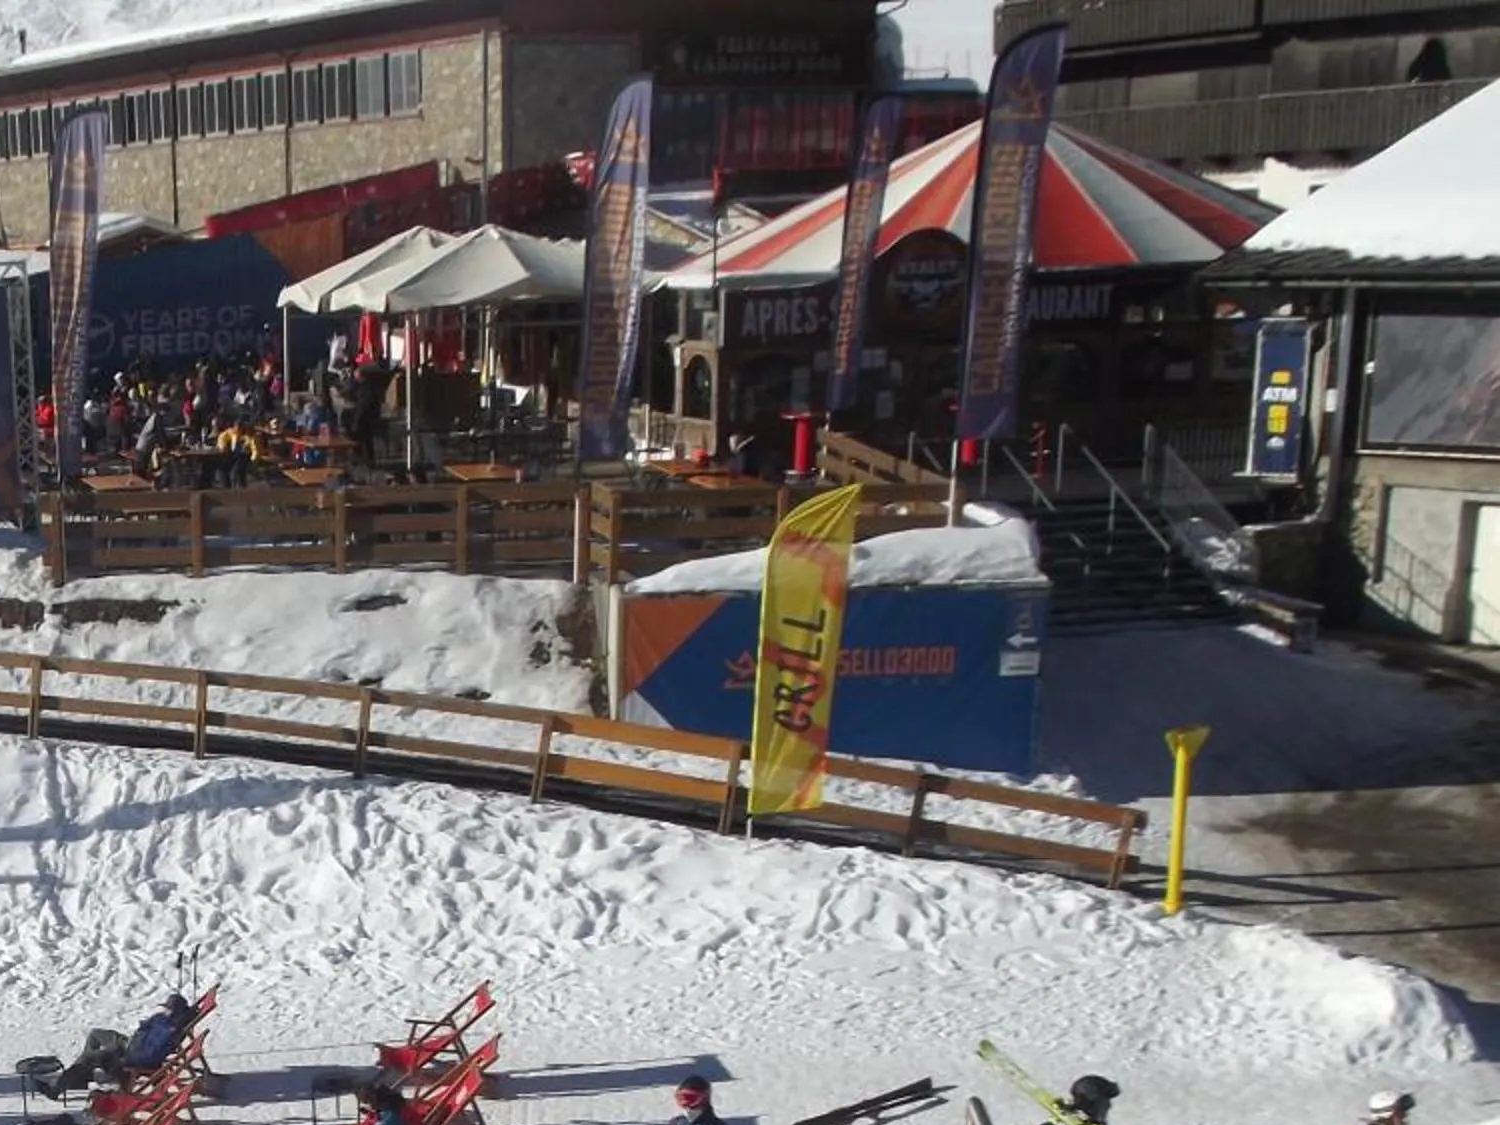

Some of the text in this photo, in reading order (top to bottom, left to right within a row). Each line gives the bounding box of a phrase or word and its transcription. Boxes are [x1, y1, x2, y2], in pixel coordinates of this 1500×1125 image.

[120, 304, 254, 332] YEARS OF
[1262, 387, 1298, 402] ATM
[772, 608, 826, 734] GRILL
